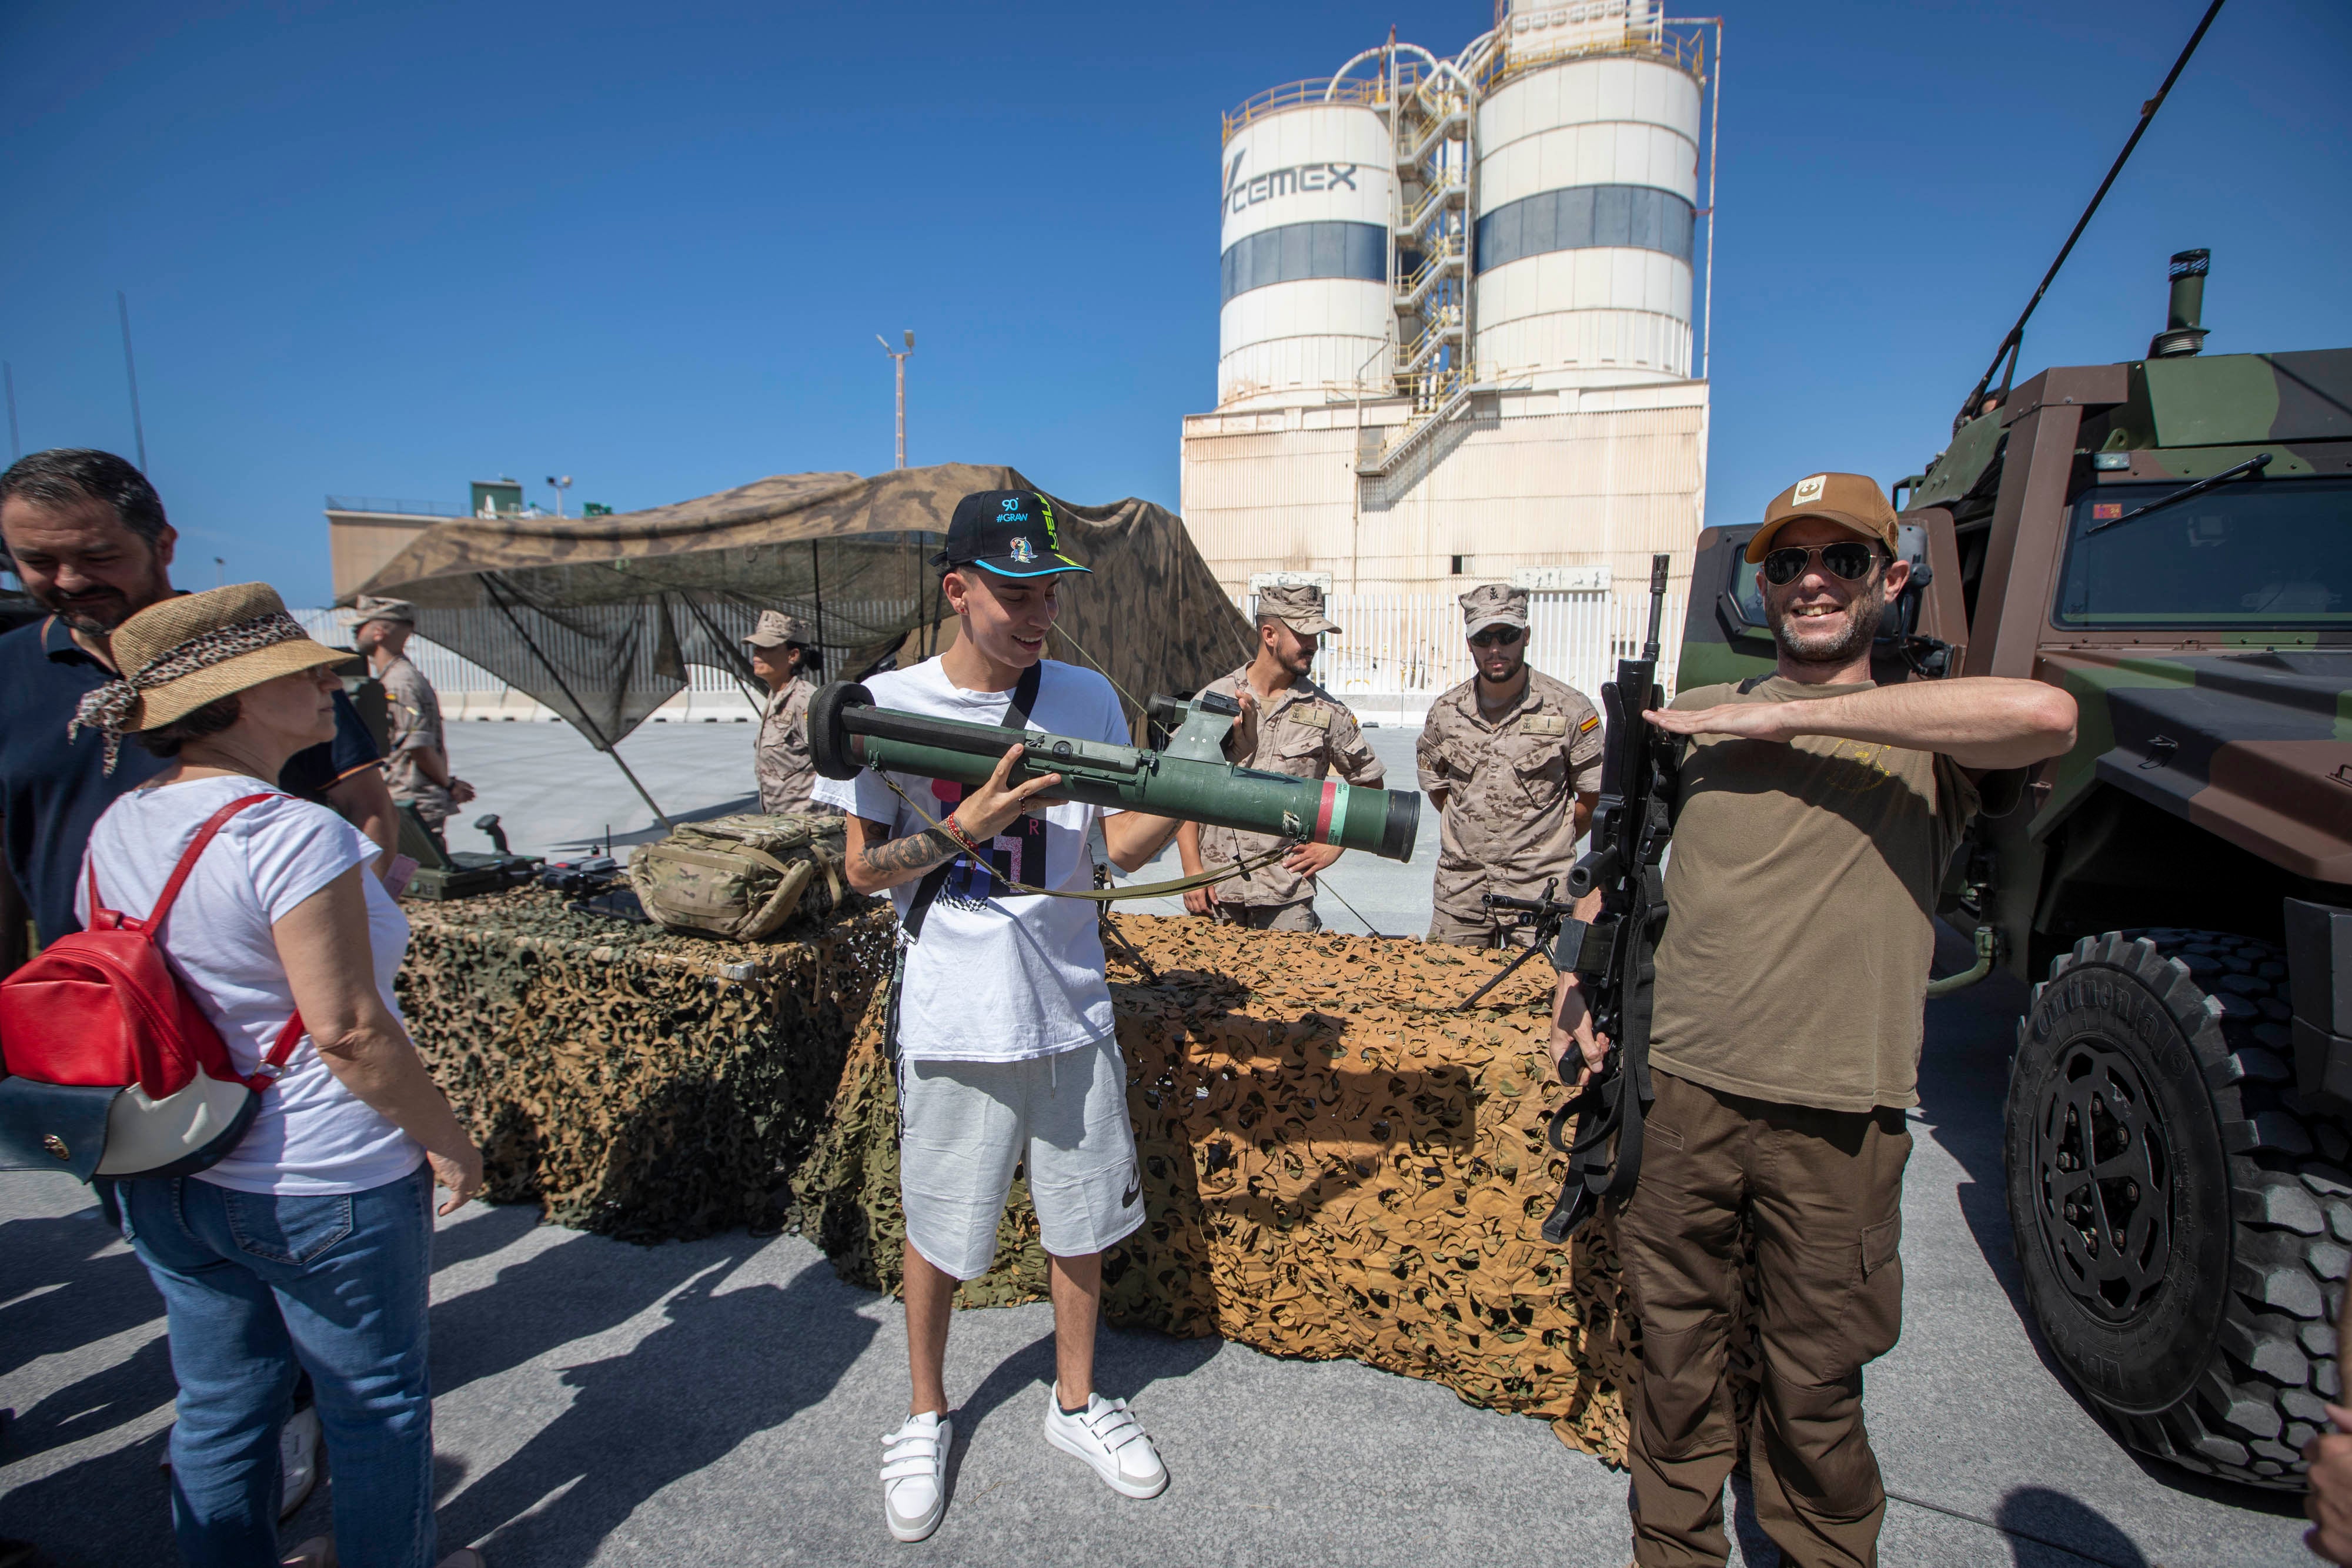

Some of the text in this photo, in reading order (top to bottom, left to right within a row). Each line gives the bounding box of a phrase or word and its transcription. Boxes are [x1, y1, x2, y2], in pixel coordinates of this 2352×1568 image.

[1232, 163, 1357, 214] CEMEX
[996, 513, 1028, 523] #GRAW
[1028, 818, 1040, 835] R
